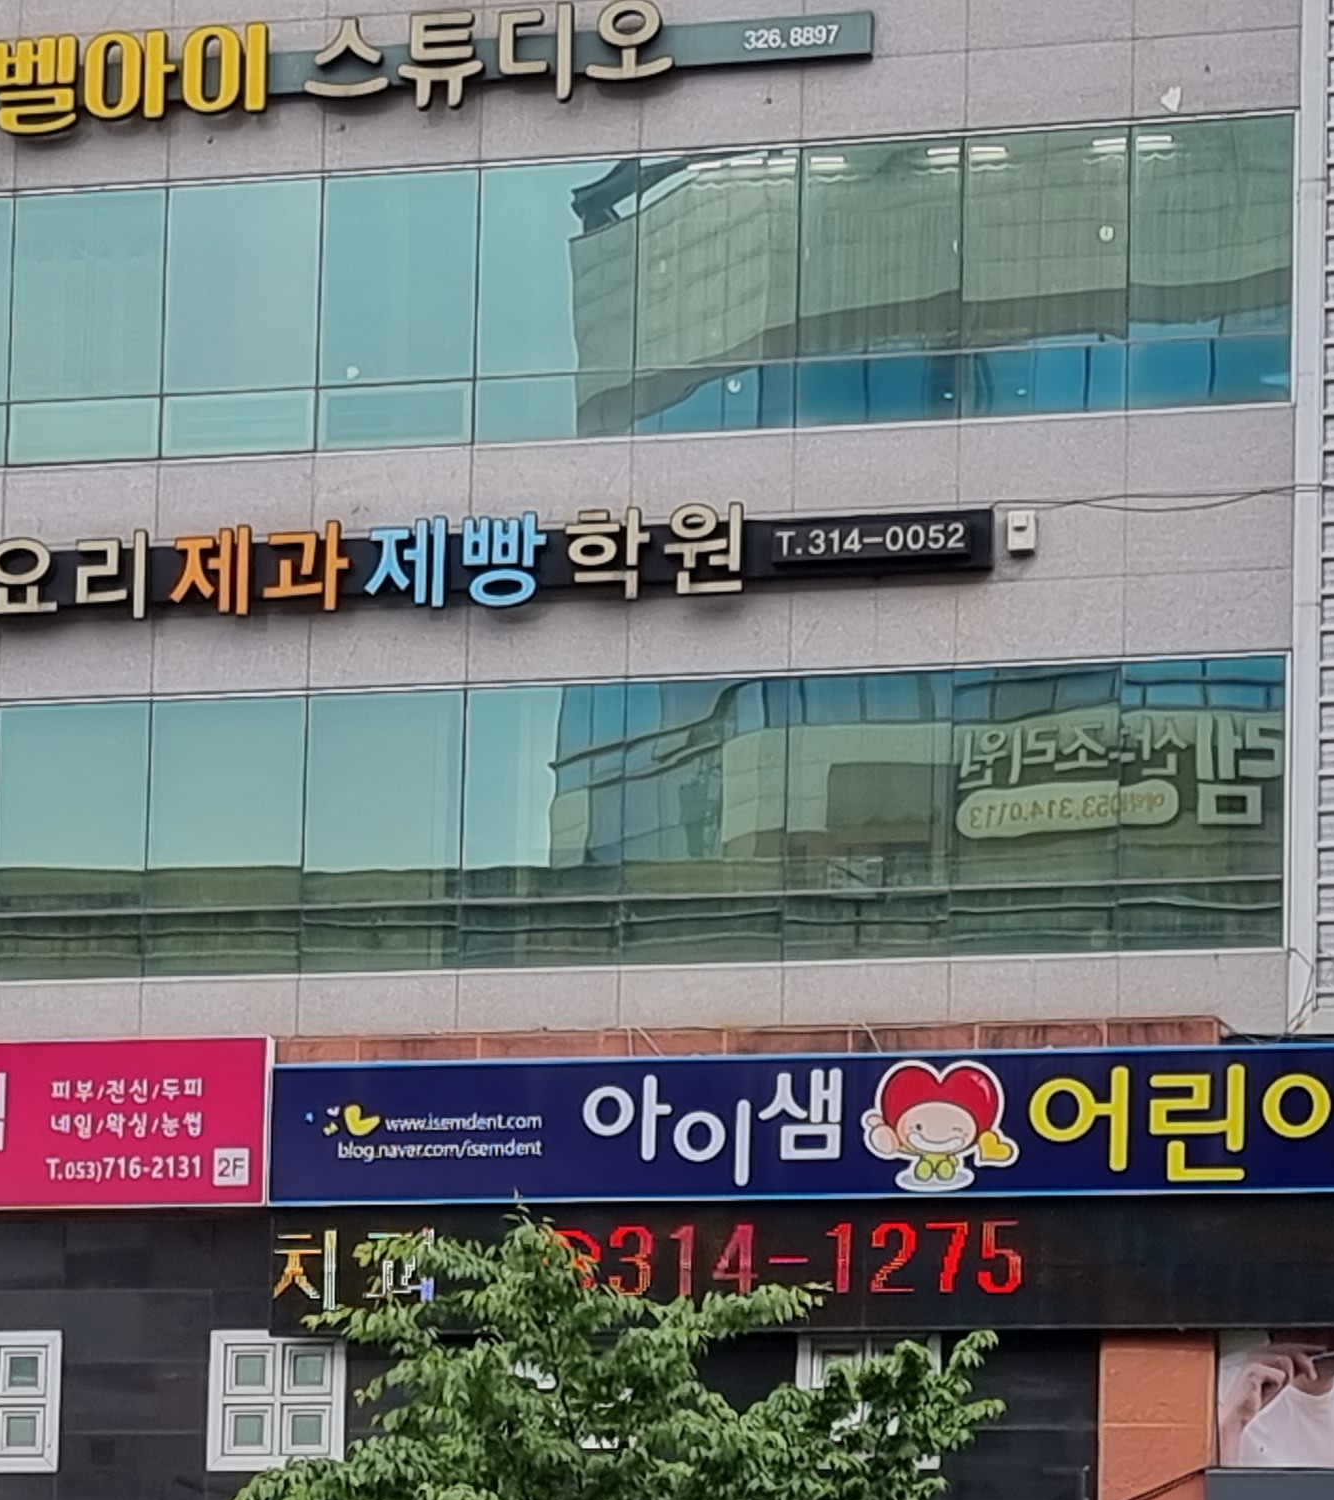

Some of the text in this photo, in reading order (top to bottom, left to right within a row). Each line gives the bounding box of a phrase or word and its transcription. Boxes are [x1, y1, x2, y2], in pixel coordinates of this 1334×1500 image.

[743, 24, 839, 51] 326.8897
[305, 0, 673, 111] 스튜디오
[776, 523, 966, 557] T.314-0052
[170, 521, 349, 615] 제과
[365, 511, 547, 607] 제빵
[566, 503, 744, 599] 학원
[50, 1076, 203, 1102] 피부/전신/두피
[385, 1112, 542, 1132] www.isemdent.com
[582, 1067, 843, 1186] 아이샘
[338, 1139, 542, 1162] blog.naver.com/isemdent
[216, 1158, 246, 1179] 2F
[610, 1219, 1023, 1298] 314-1275
